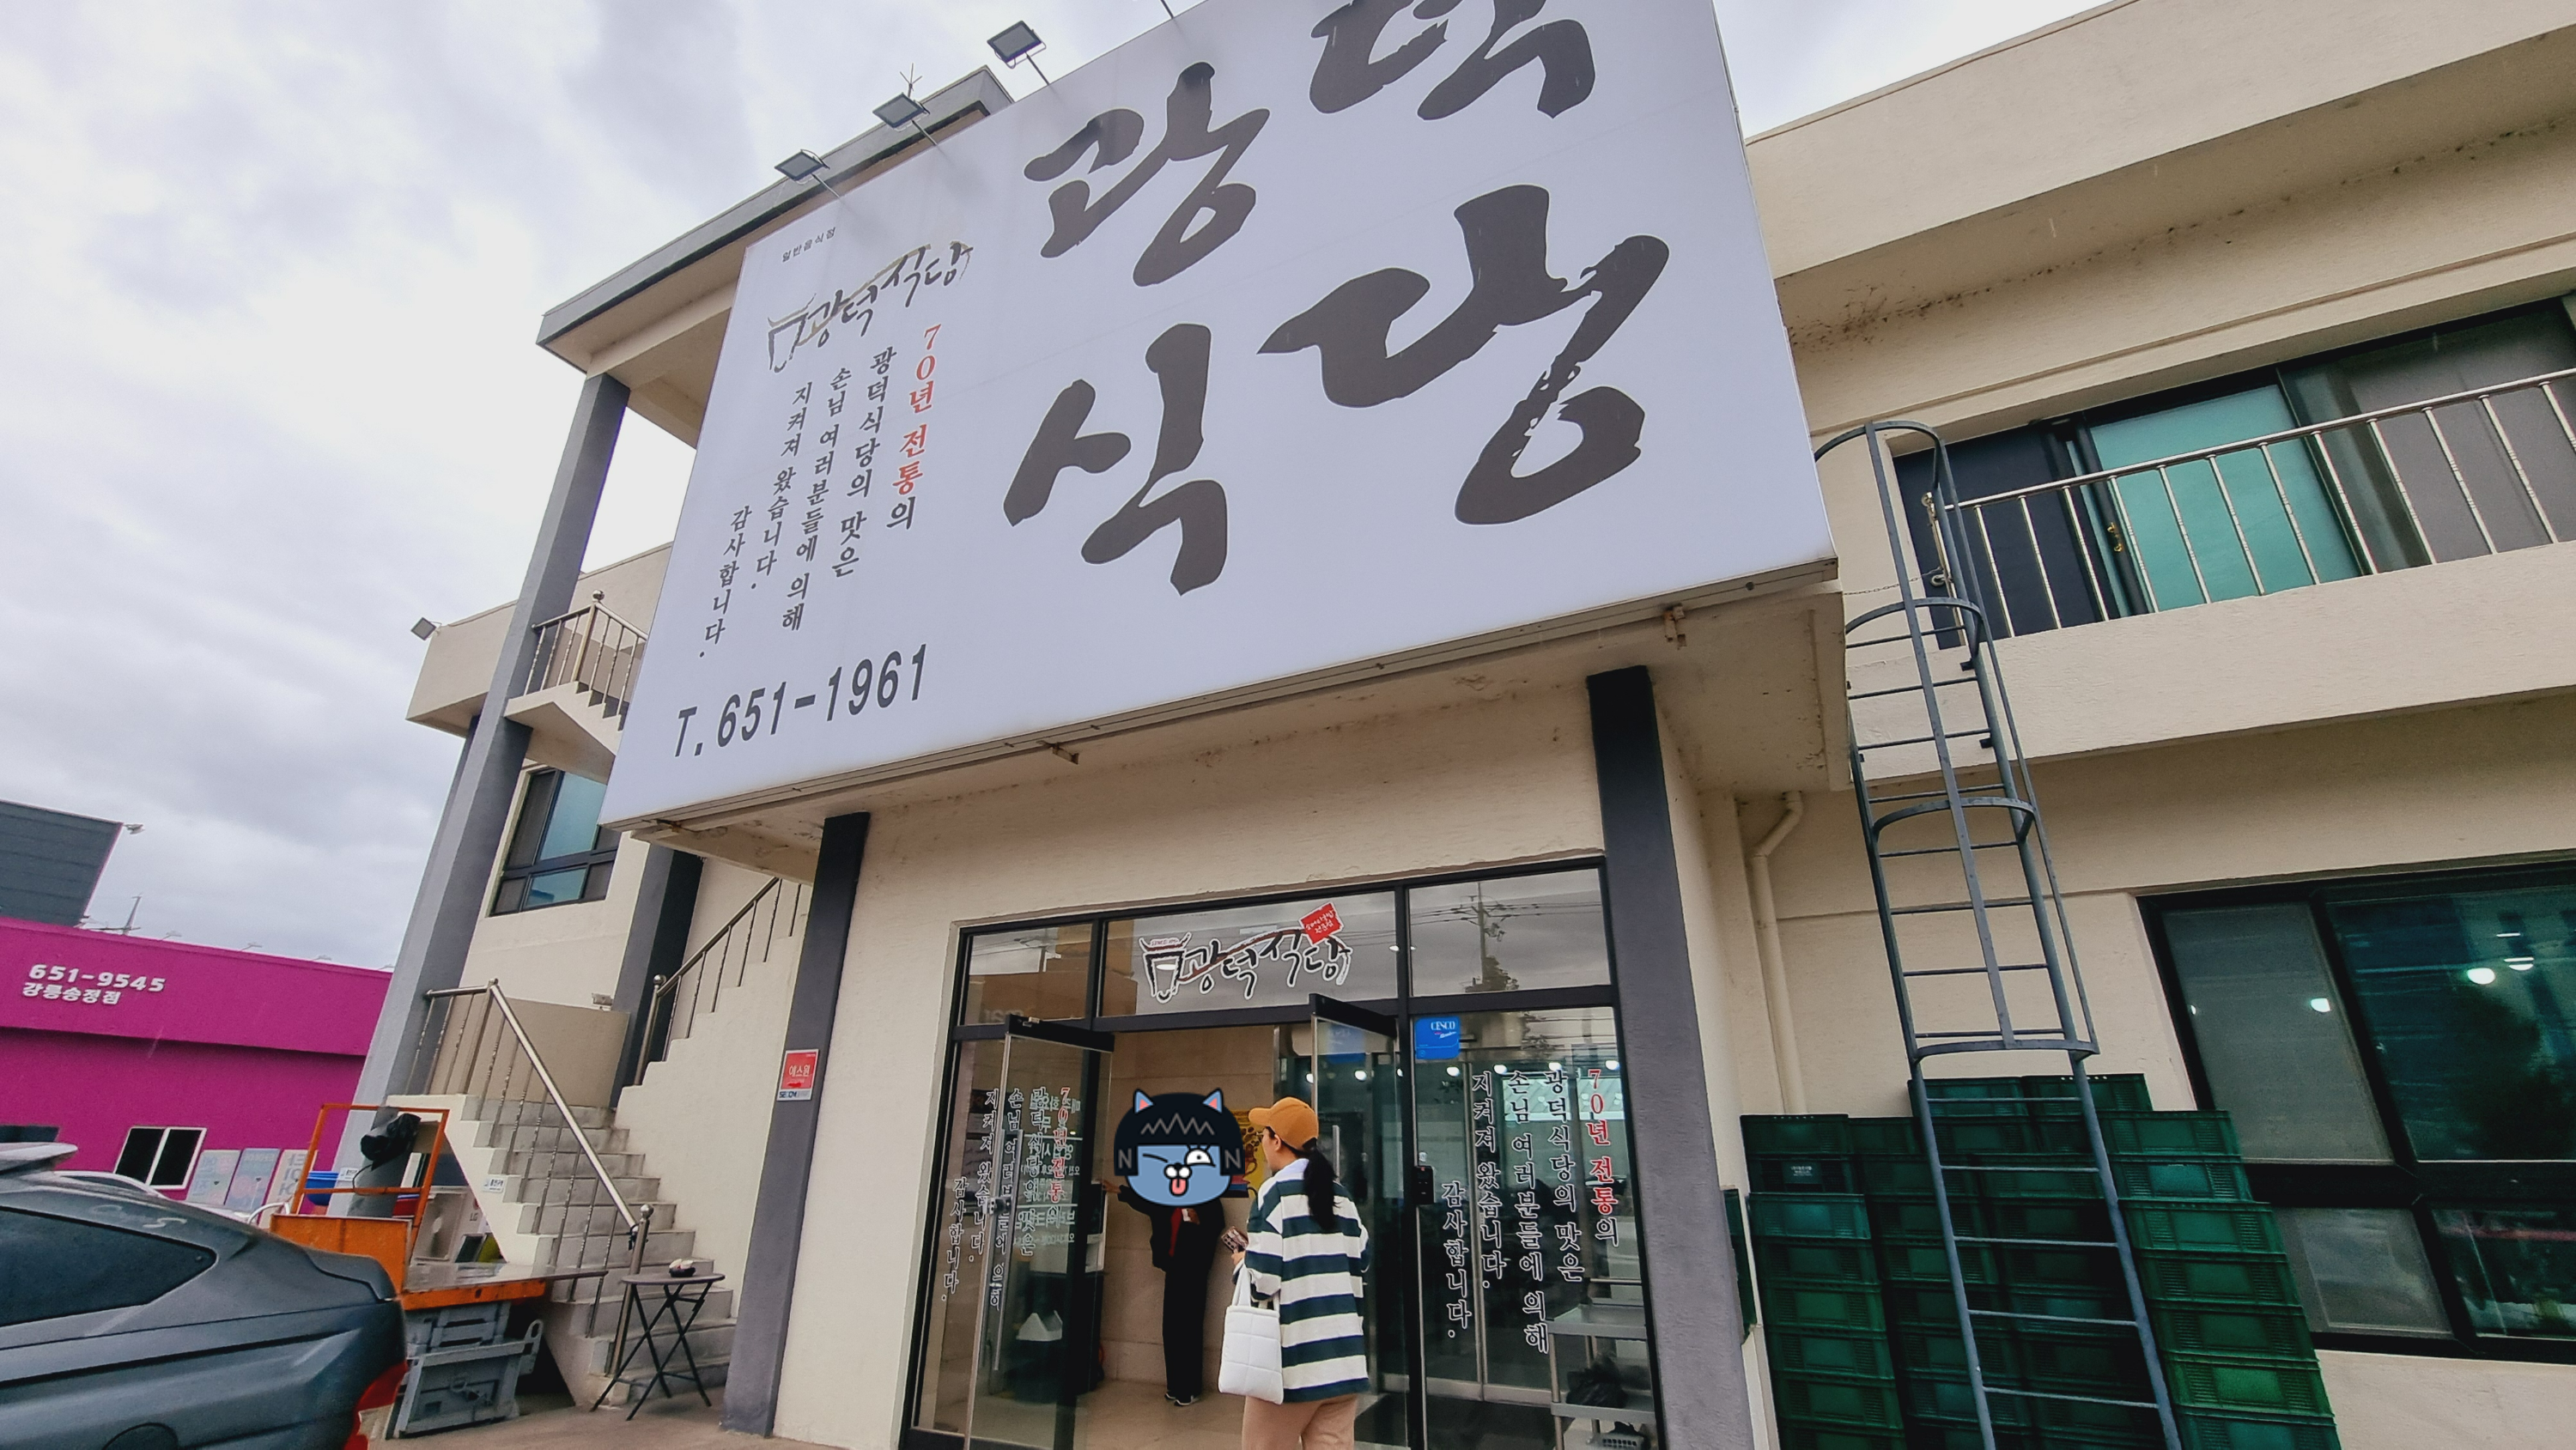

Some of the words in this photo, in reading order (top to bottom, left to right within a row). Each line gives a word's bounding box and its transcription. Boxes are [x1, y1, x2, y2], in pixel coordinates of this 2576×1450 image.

[782, 227, 836, 263] 일반음식점
[828, 367, 852, 417] 손님
[908, 324, 942, 413] 70년
[1004, 185, 1670, 596] 식당
[780, 381, 813, 458] 지켜져
[847, 346, 897, 498] 광덕식당의
[795, 423, 840, 562] 여러분들에
[886, 424, 927, 530] 전통의
[750, 465, 797, 590] 왔습니다.
[831, 510, 867, 578] 맛은
[699, 505, 753, 659] 감사합니다.
[782, 572, 810, 631] 의해
[675, 644, 927, 757] T.651-1961
[22, 982, 122, 1005] 강릉송정점
[28, 963, 166, 992] 651-9545
[788, 1065, 811, 1077] 에스원
[1473, 1071, 1496, 1153] 지켜져
[1508, 1071, 1531, 1124] 손님
[1587, 1069, 1610, 1145] 70년
[1544, 1070, 1577, 1212] 광덕식당의
[941, 1177, 969, 1301] 감사합니다.
[1476, 1162, 1507, 1289] 왔습니다.
[1511, 1133, 1543, 1282] 여러분들에
[1589, 1156, 1619, 1247] 전통의
[1442, 1180, 1472, 1338] 감사합니다.
[1554, 1222, 1585, 1282] 맛은
[1522, 1290, 1549, 1354] 의해
